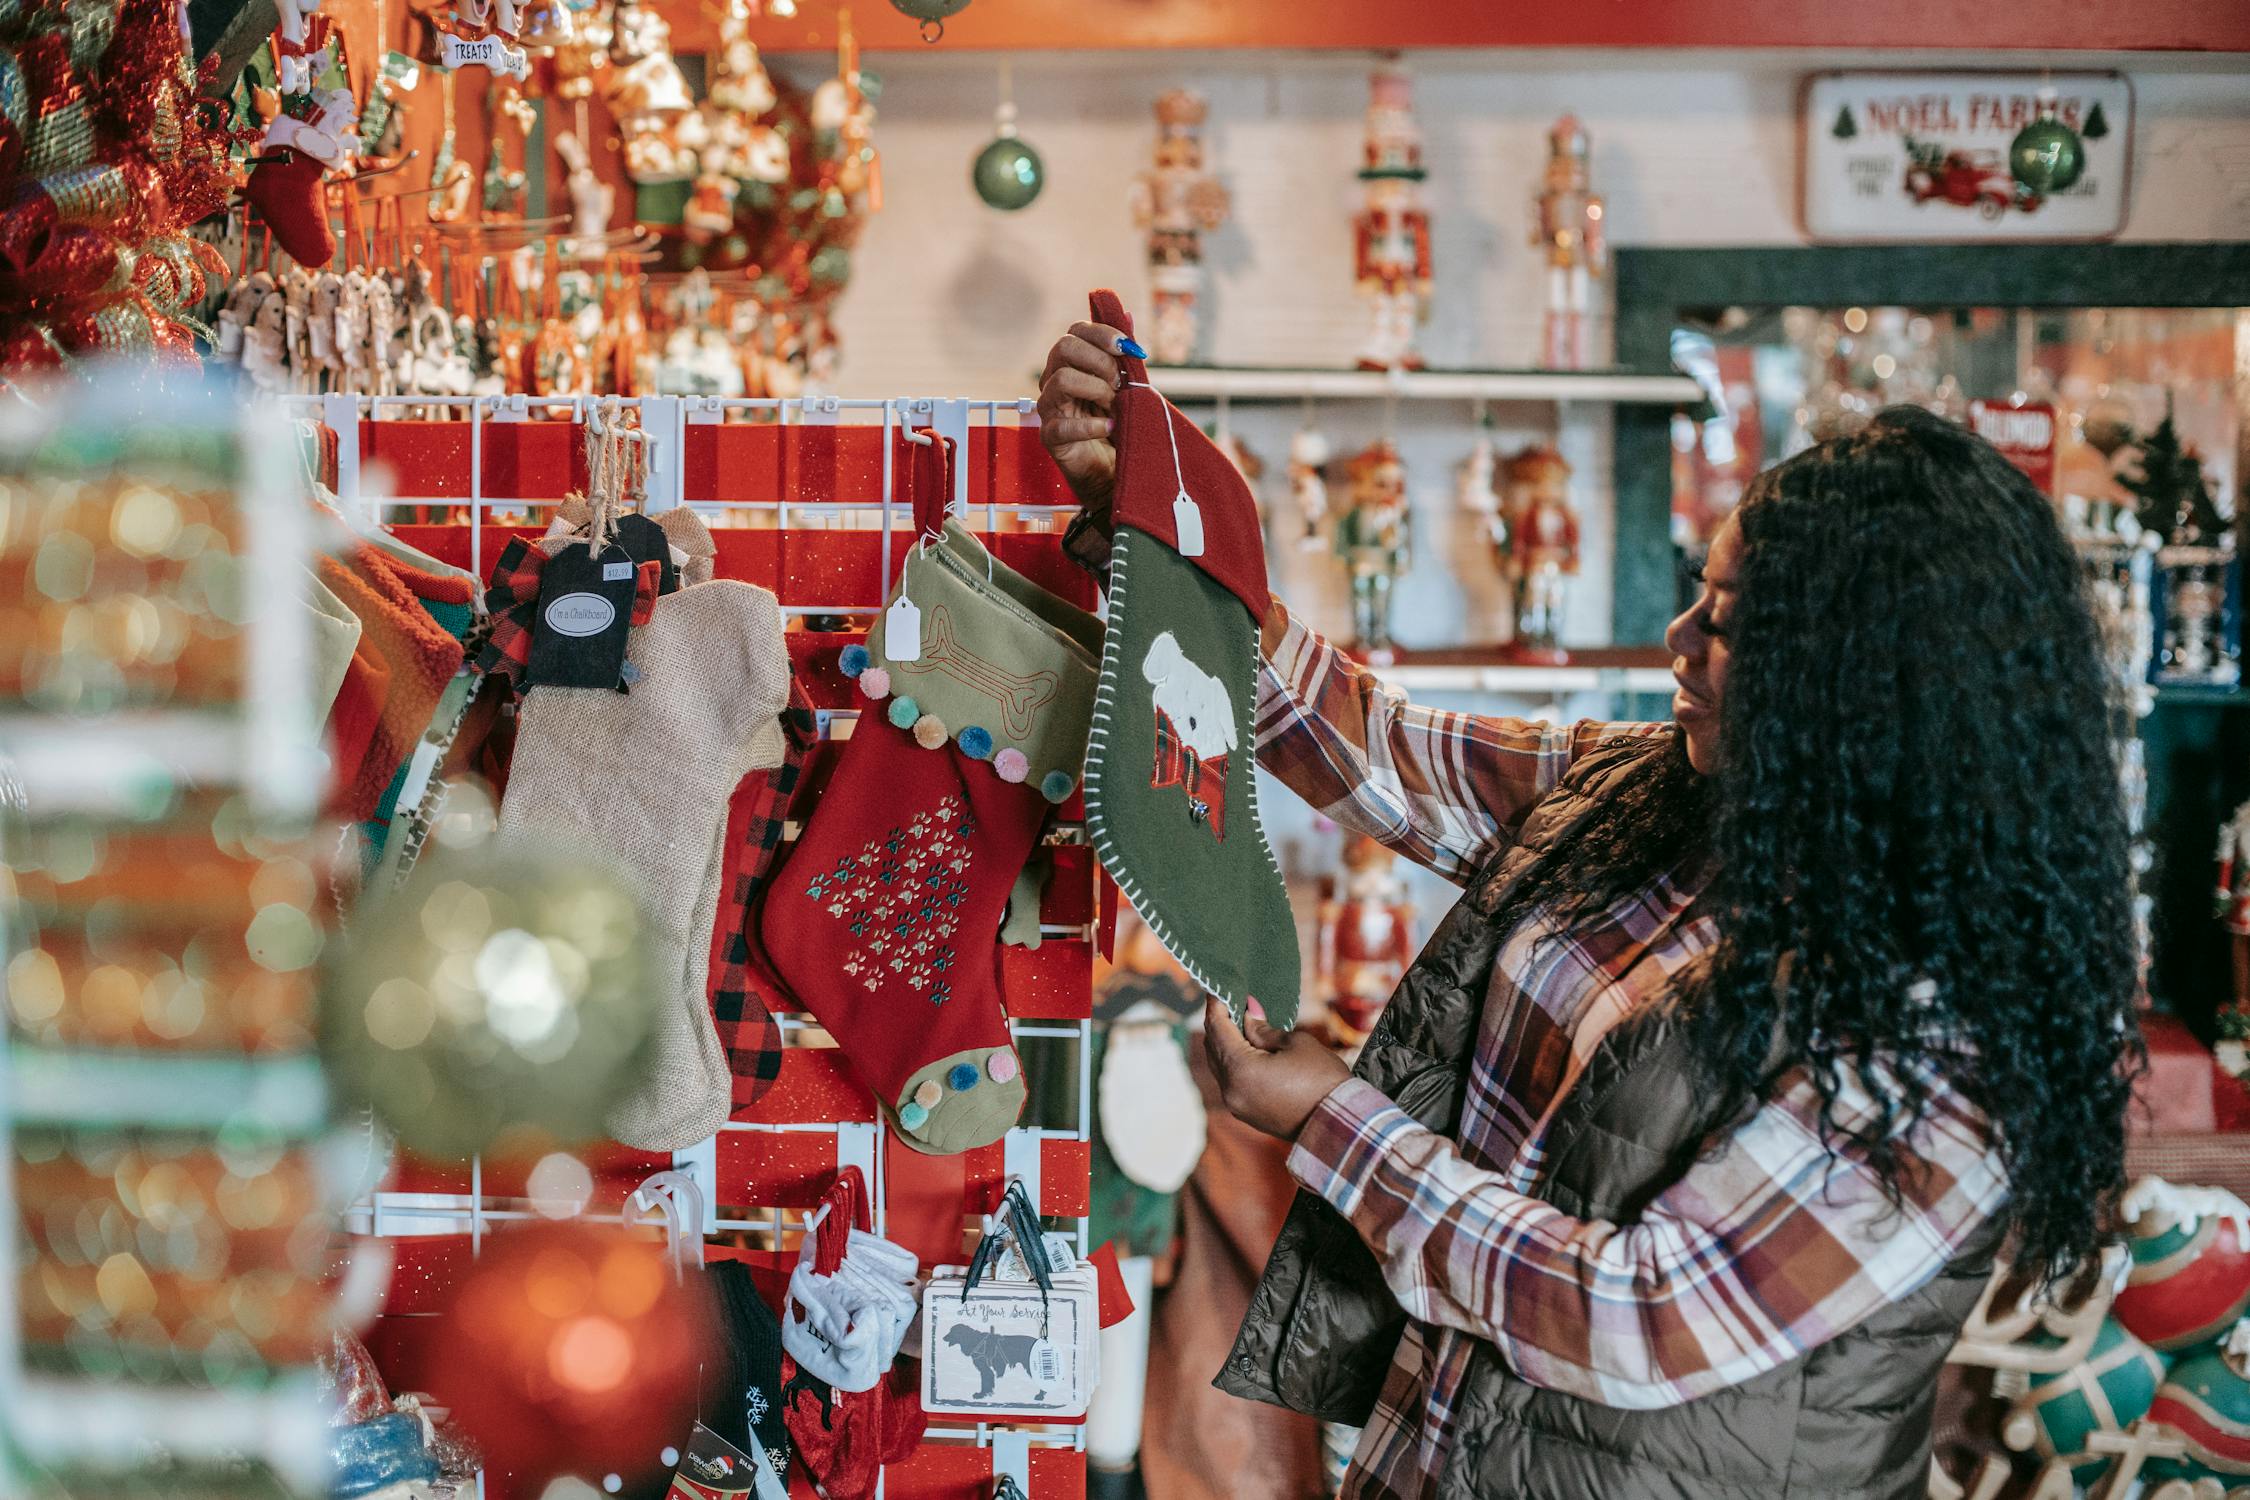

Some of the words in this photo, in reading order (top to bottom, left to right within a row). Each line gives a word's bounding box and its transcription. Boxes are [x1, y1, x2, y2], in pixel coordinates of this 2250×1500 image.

[455, 43, 493, 60] TREATS?
[570, 607, 608, 619] Chalkboard
[957, 1303, 977, 1317] At
[980, 1304, 1006, 1323] Your
